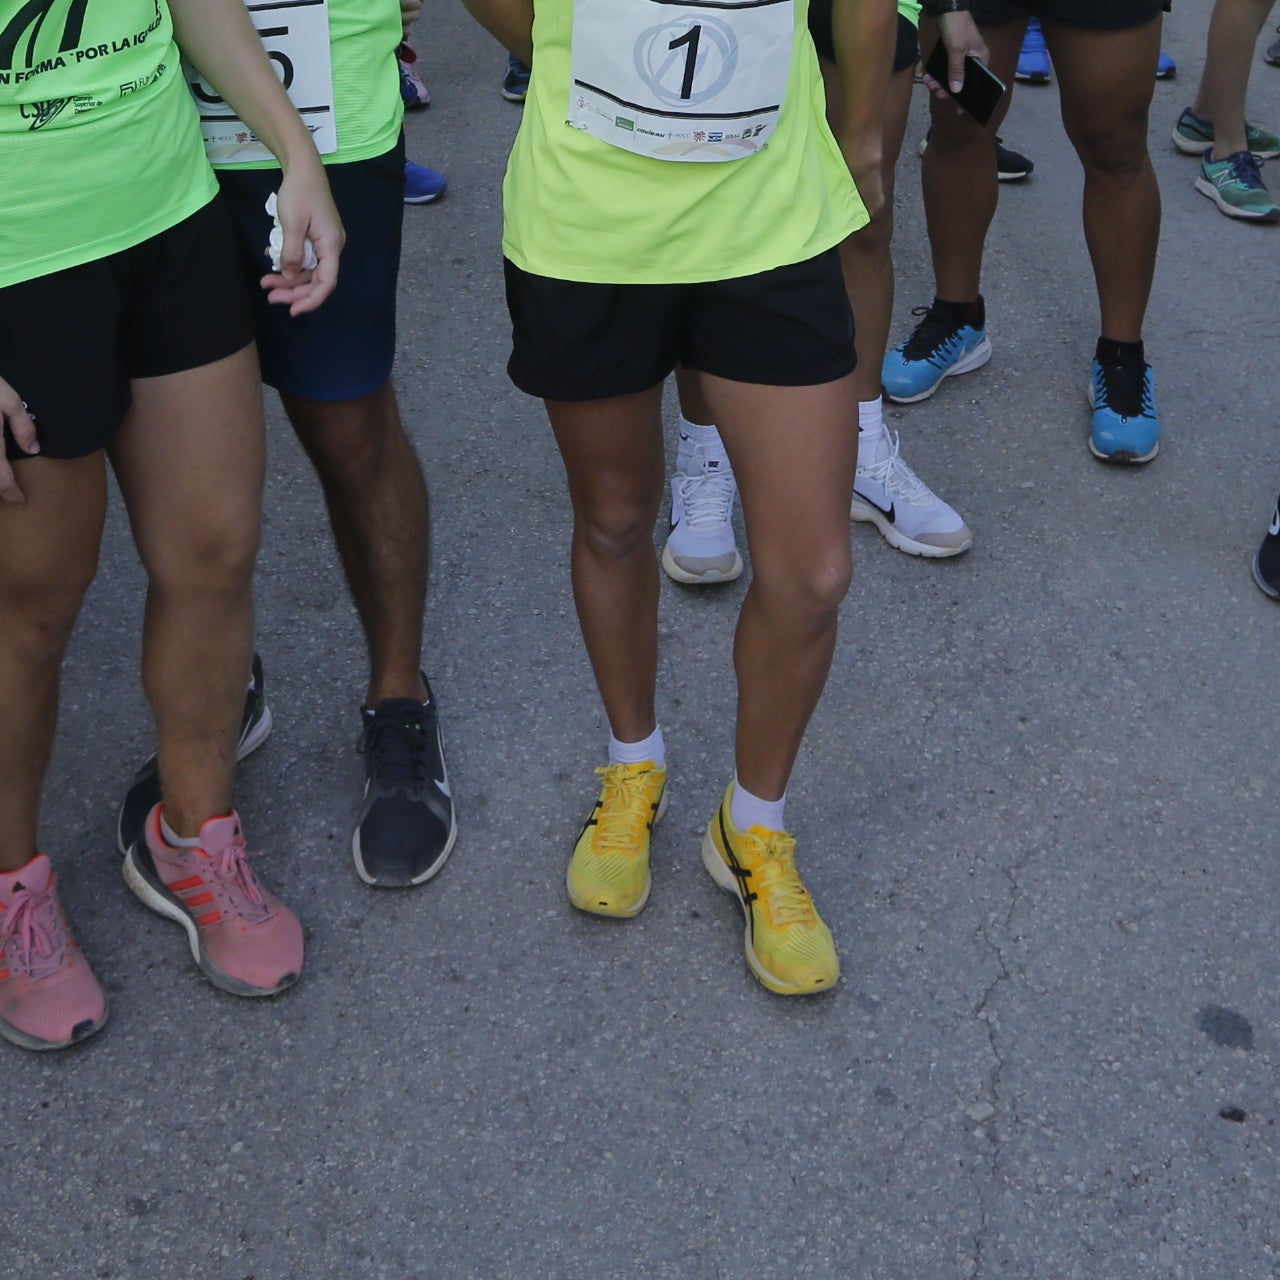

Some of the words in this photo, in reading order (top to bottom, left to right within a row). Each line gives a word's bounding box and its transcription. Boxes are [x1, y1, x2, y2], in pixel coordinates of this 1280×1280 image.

[76, 44, 109, 63] POR
[113, 37, 130, 53] LA
[668, 25, 701, 100] 1
